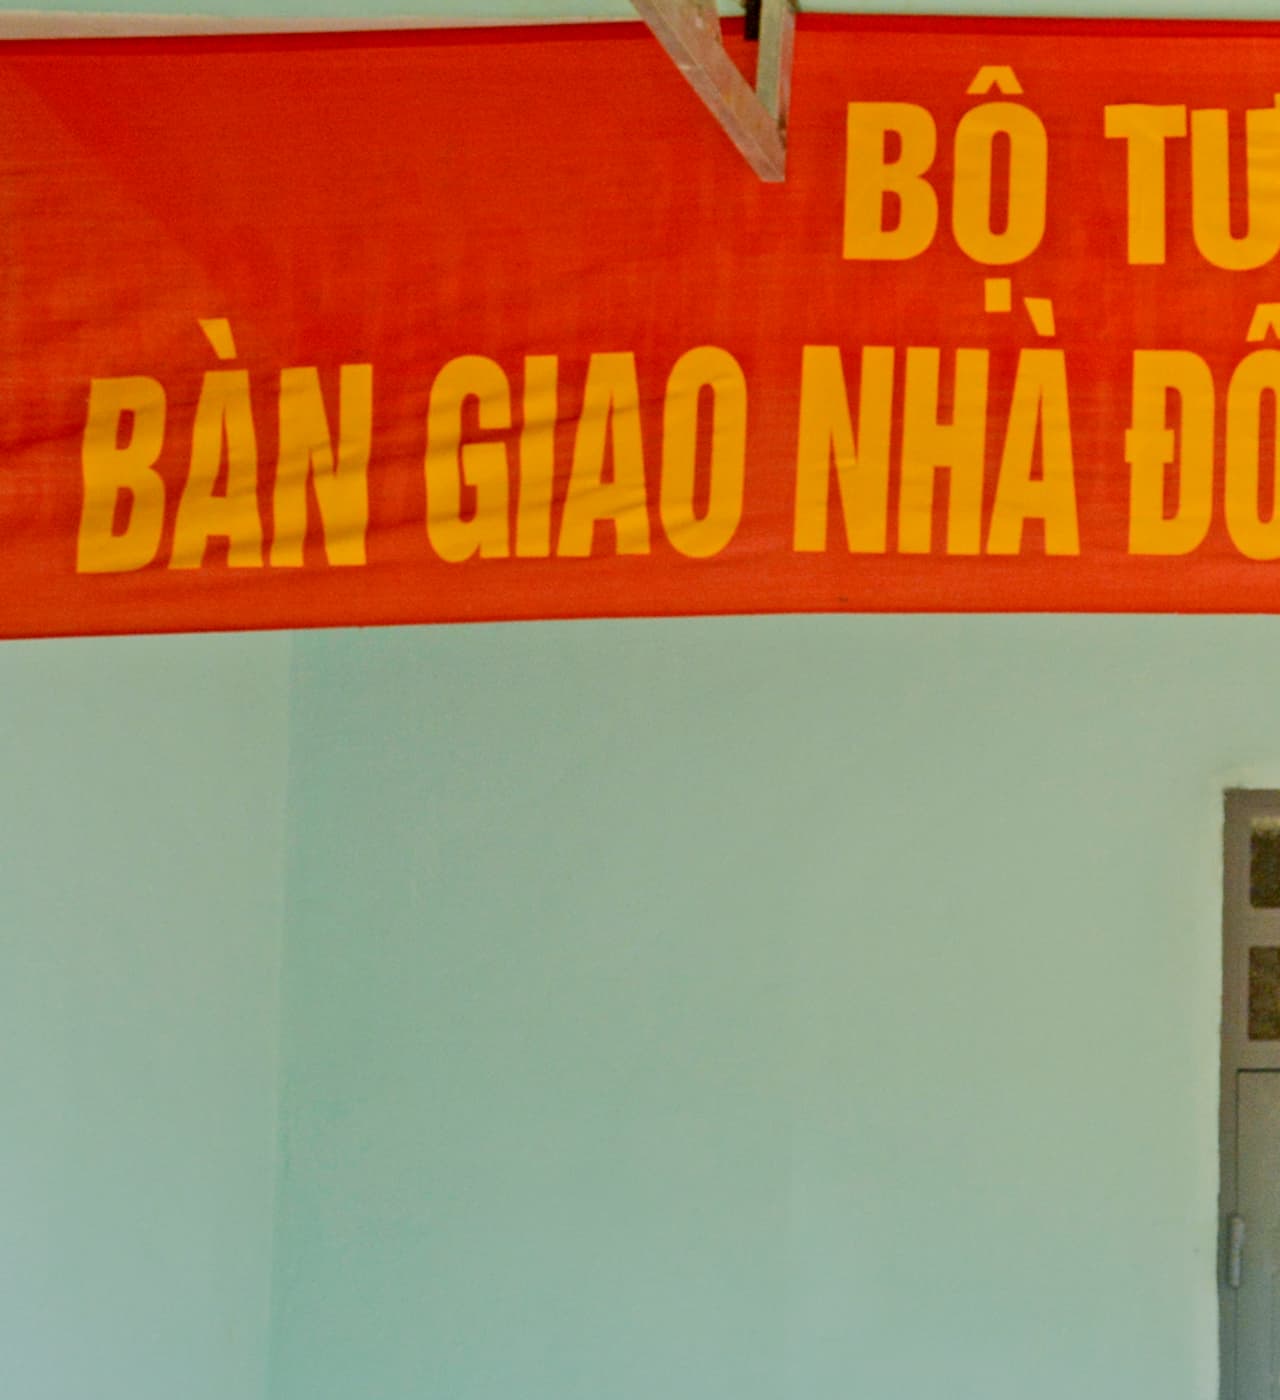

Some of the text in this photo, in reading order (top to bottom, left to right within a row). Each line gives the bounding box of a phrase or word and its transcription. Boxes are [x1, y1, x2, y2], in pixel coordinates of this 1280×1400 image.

[843, 65, 1048, 313] BỘ
[76, 318, 373, 575] BÀN
[424, 346, 748, 563] GIAO
[793, 297, 1081, 556] NHÀ
